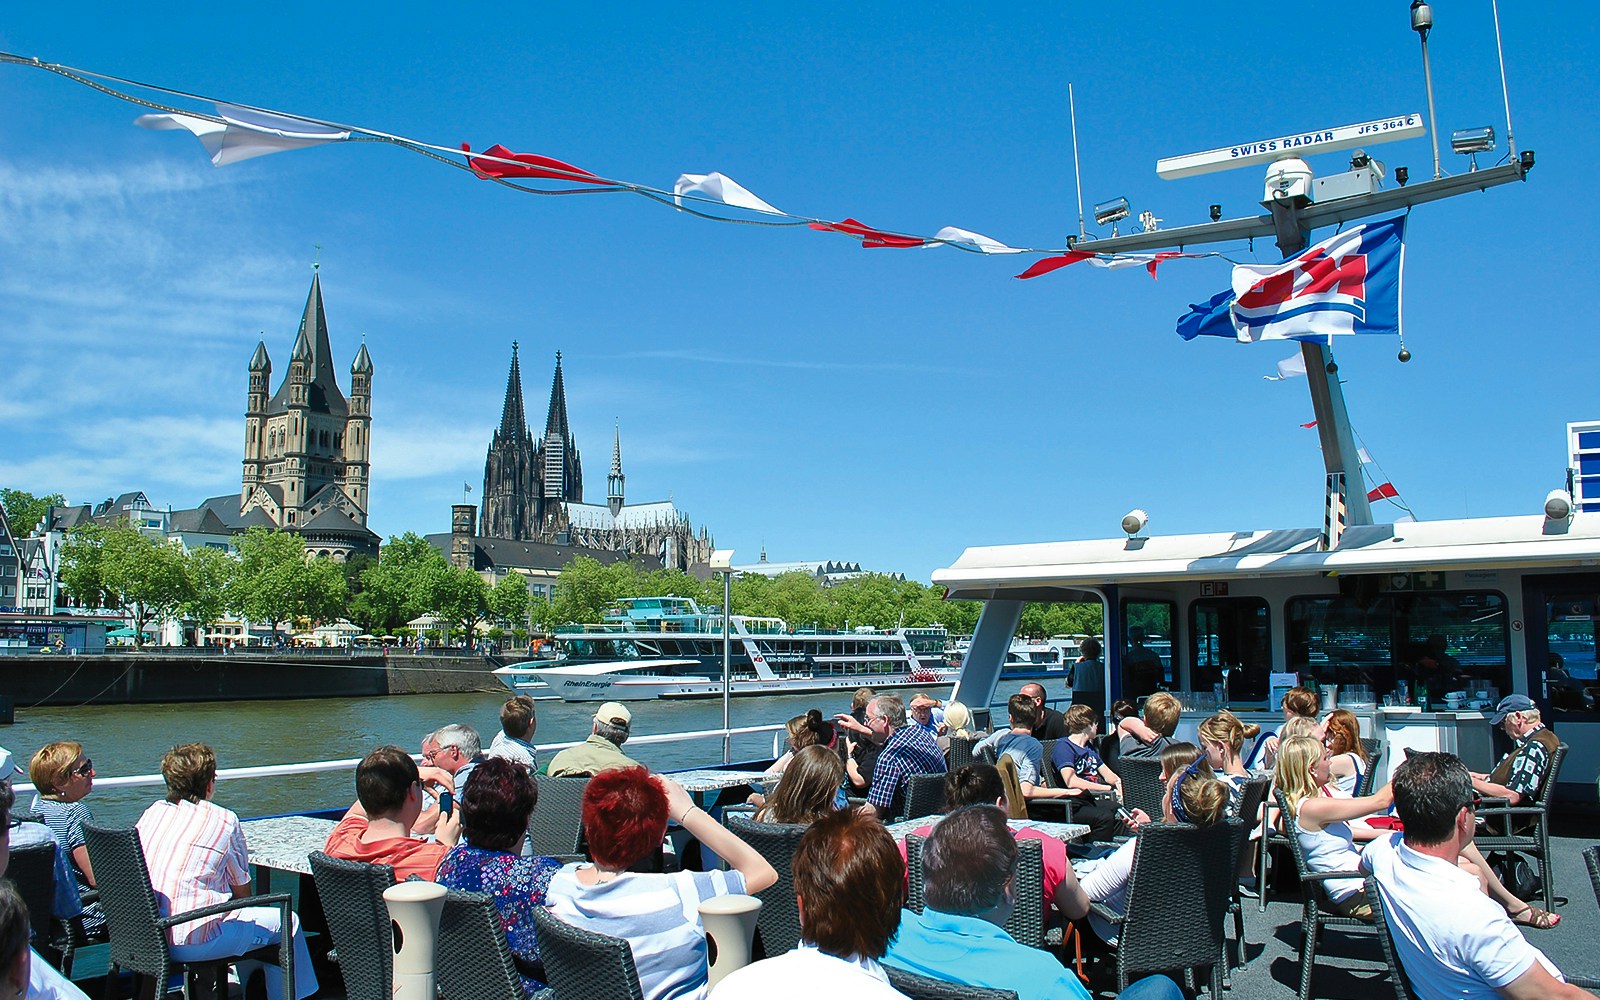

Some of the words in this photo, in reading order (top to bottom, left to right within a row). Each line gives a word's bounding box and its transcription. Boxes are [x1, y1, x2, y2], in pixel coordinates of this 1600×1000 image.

[1358, 124, 1379, 135] JFS
[1383, 120, 1403, 130] 364
[1406, 117, 1415, 126] C
[1231, 141, 1277, 157] SWISS
[1283, 132, 1334, 149] RADAR
[1204, 584, 1211, 595] F
[563, 680, 611, 689] RheinEnergie
